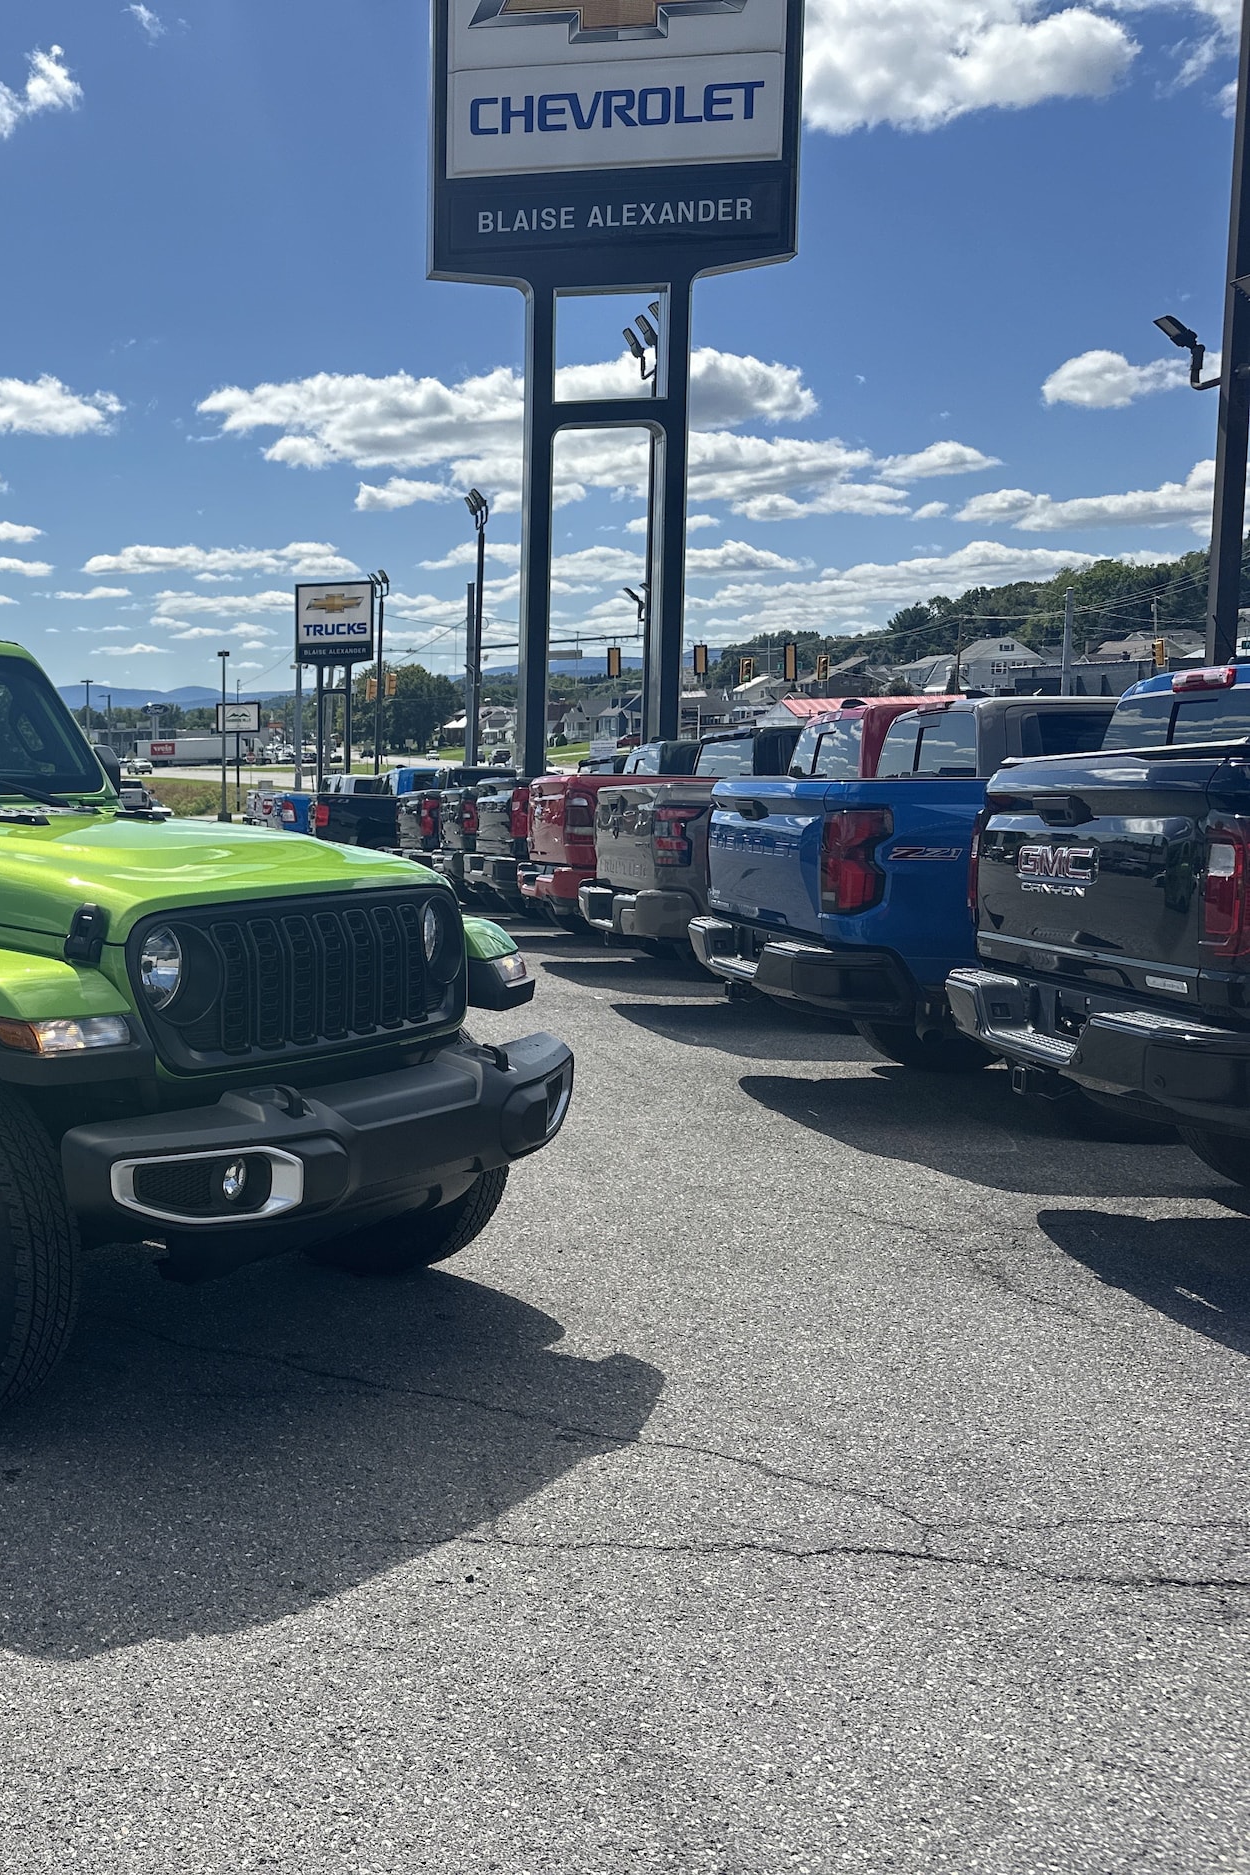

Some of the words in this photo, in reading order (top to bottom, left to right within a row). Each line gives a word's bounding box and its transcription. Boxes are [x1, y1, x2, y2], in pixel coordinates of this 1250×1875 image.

[470, 81, 765, 136] CHEVROLET
[477, 206, 576, 234] BLAISE
[587, 198, 753, 229] ALEXANDER
[303, 622, 367, 637] TRUCKS
[303, 648, 327, 656] BLAISE
[329, 647, 367, 655] ALEXANDER
[1017, 845, 1095, 879] GMC
[1021, 882, 1086, 897] CANYON
